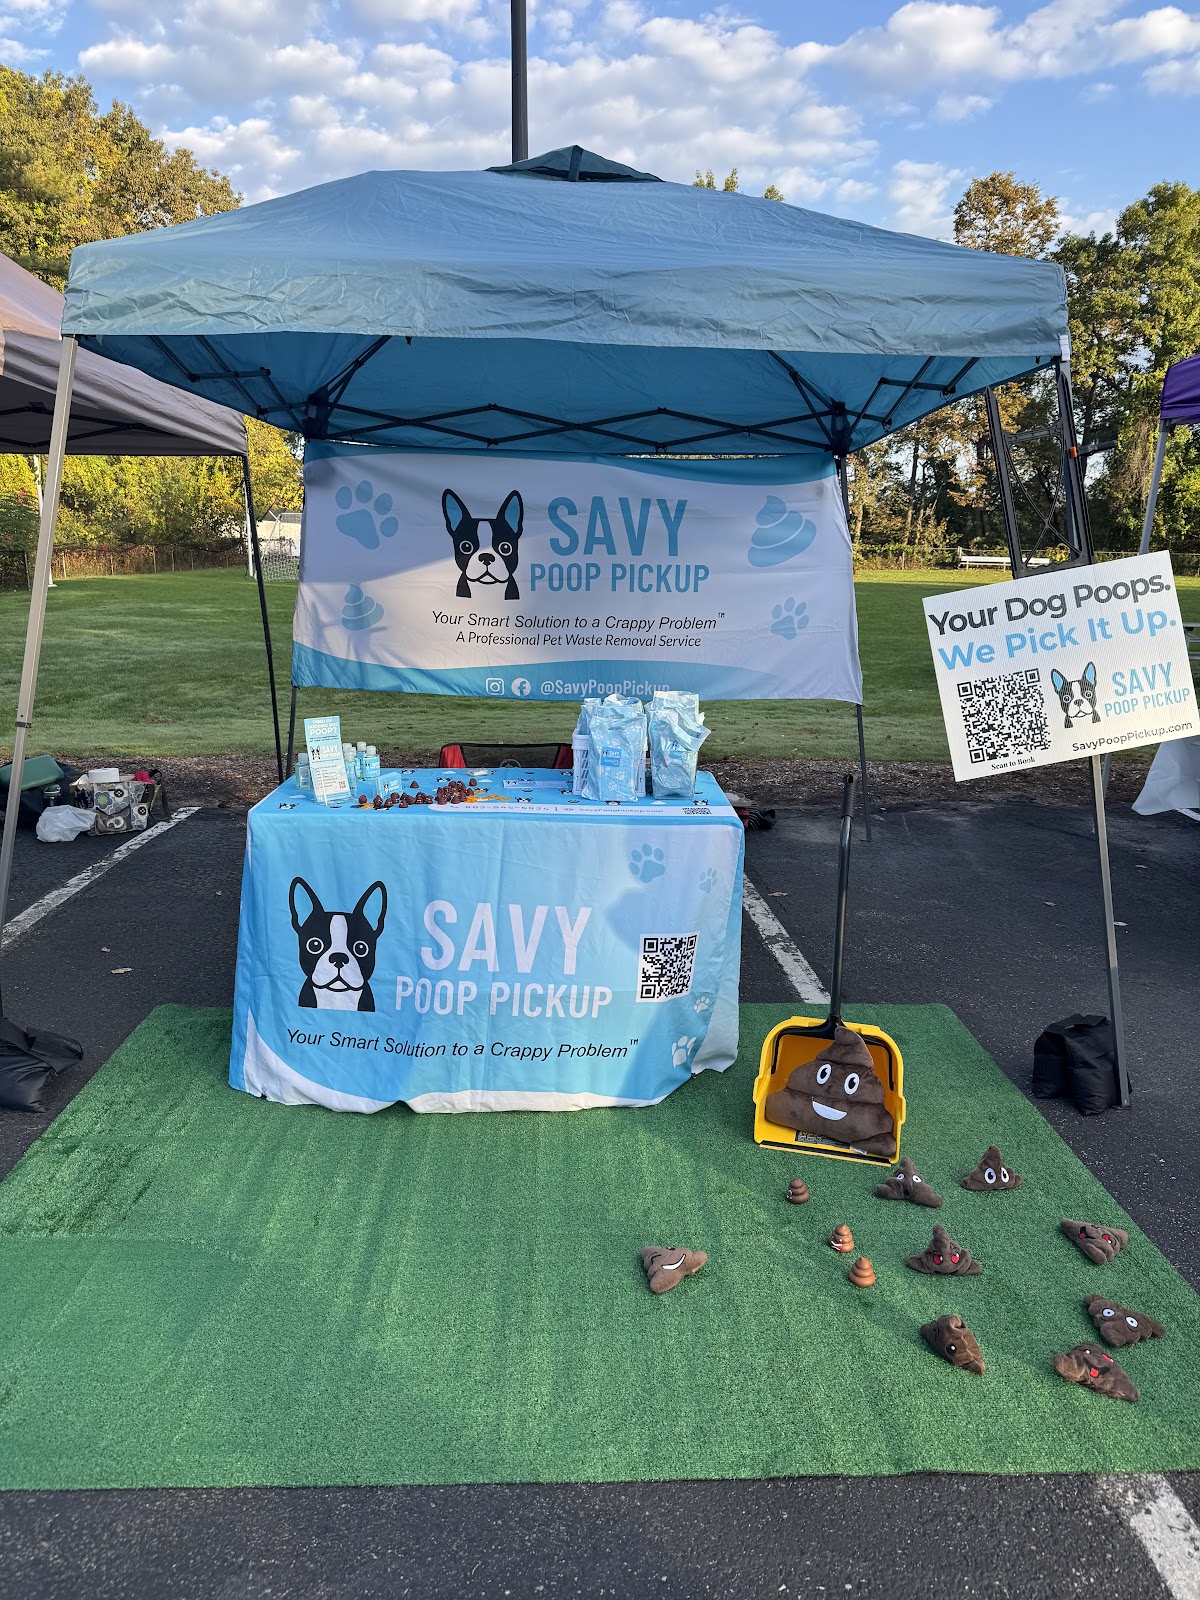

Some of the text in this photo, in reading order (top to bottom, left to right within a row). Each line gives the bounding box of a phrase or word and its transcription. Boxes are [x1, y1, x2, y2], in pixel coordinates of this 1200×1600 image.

[547, 496, 688, 556] SAVY
[530, 563, 710, 593] POOP PICKUP
[928, 574, 1171, 636] Your Dog Poops.
[432, 610, 464, 625] Your
[467, 613, 510, 628] Smart
[514, 615, 570, 628] Solution
[574, 616, 588, 628] to
[591, 618, 600, 628] a
[605, 616, 655, 632] Crappy
[455, 631, 702, 647] A Professional Pet Waste Removal Service
[937, 609, 1177, 671] We Pick It Up.
[1111, 661, 1172, 697] SAVY
[1104, 687, 1190, 718] POOP PICKUP
[309, 726, 337, 736] POOP?
[1072, 722, 1193, 752] SavyPoopPickup.com
[1017, 756, 1036, 765] Book
[420, 900, 592, 975] SAVY
[395, 975, 613, 1019] POOP PICKUP
[287, 1029, 325, 1046] Your
[329, 1032, 379, 1051] Smart
[383, 1038, 446, 1057] Solution
[452, 1043, 468, 1056] to
[473, 1045, 485, 1055] a
[490, 1042, 553, 1061] Crappy
